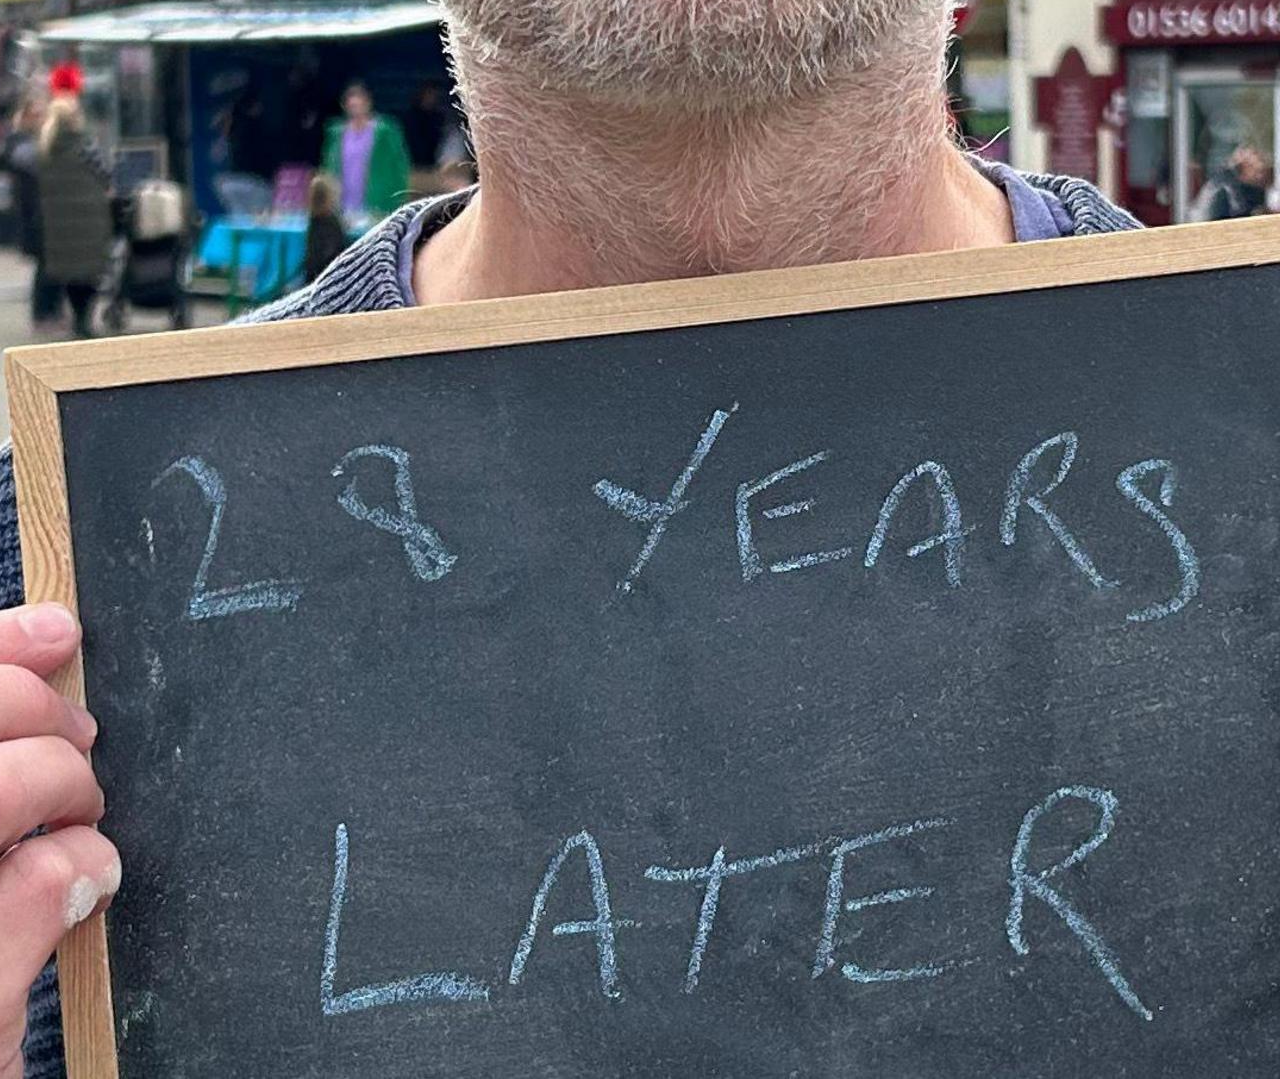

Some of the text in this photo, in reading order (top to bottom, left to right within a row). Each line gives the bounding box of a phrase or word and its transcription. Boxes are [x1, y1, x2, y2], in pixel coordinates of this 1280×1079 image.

[1127, 2, 1210, 39] 01536
[150, 401, 1200, 623] 28 YEARS
[320, 783, 1154, 1021] LATER
